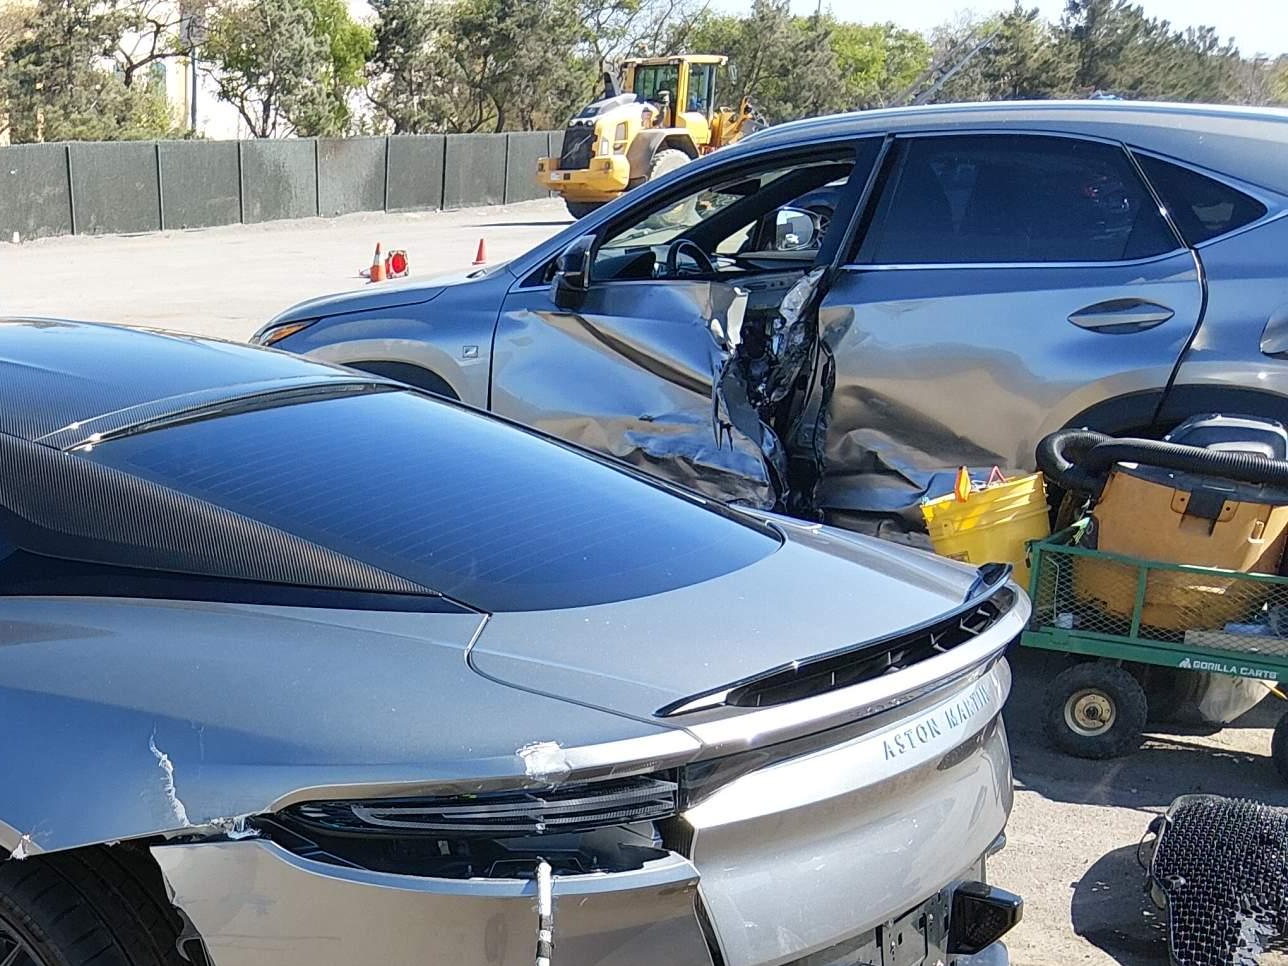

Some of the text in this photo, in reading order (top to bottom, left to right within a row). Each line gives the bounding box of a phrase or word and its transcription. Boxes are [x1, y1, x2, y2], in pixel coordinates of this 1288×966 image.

[1192, 660, 1277, 680] GORILLA CARTS
[882, 684, 991, 761] ASTON MARTIN
